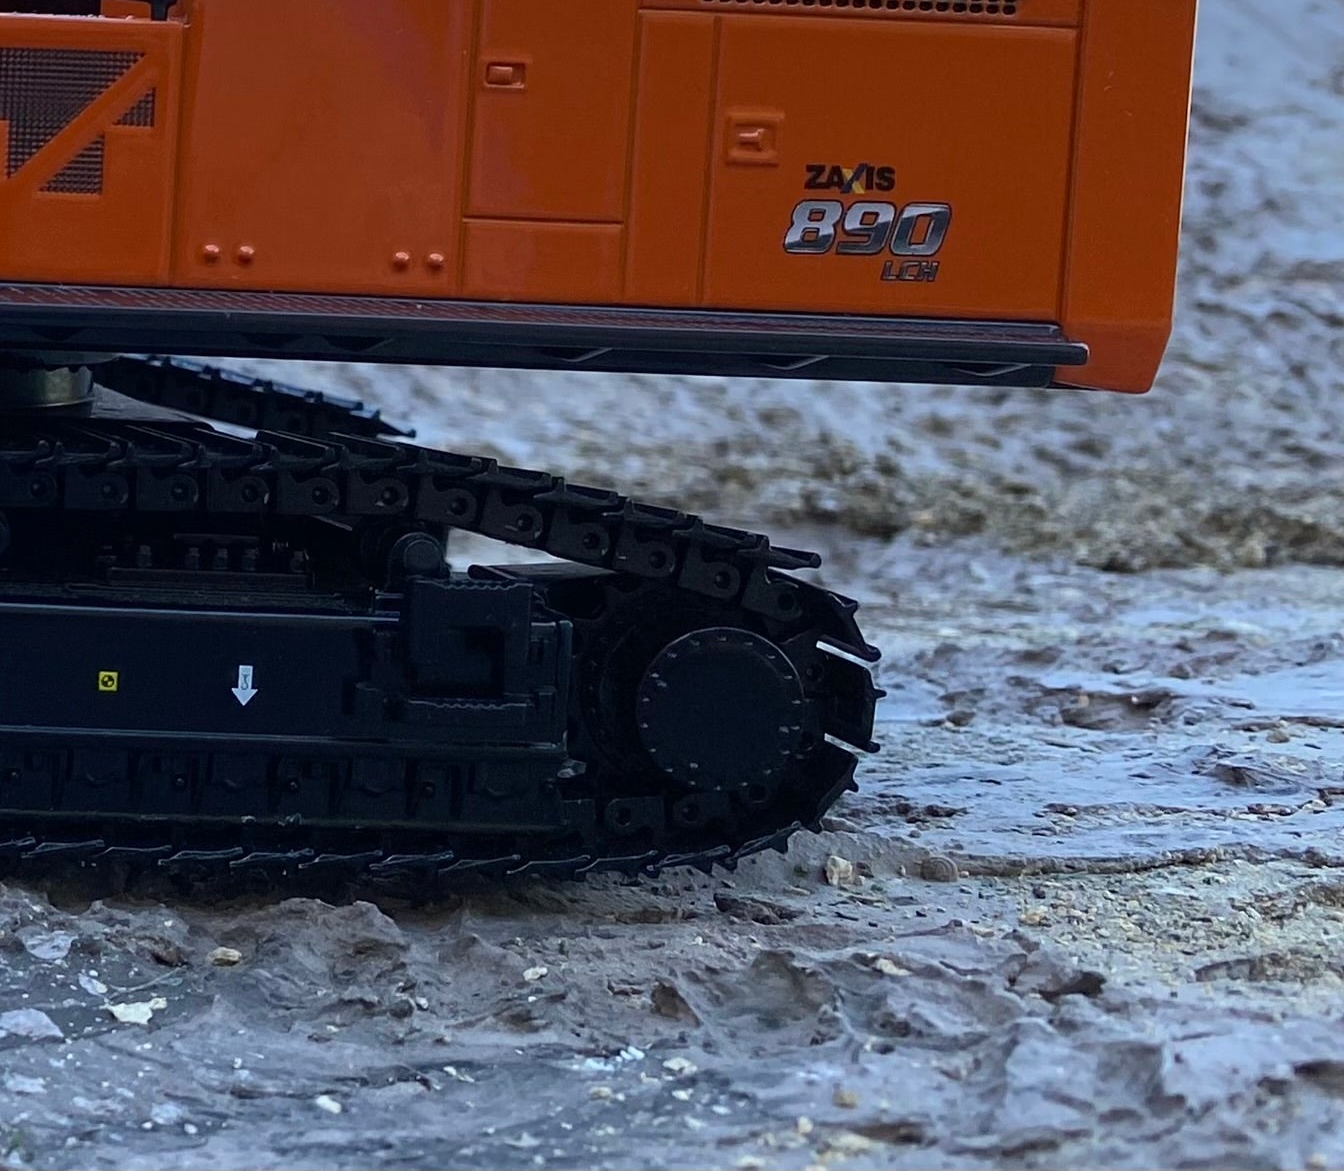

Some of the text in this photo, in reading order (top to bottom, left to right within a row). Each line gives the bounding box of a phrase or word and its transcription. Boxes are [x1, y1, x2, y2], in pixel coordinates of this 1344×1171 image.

[804, 163, 896, 194] ZAXIS
[782, 199, 952, 257] 890
[880, 260, 940, 283] LCH
